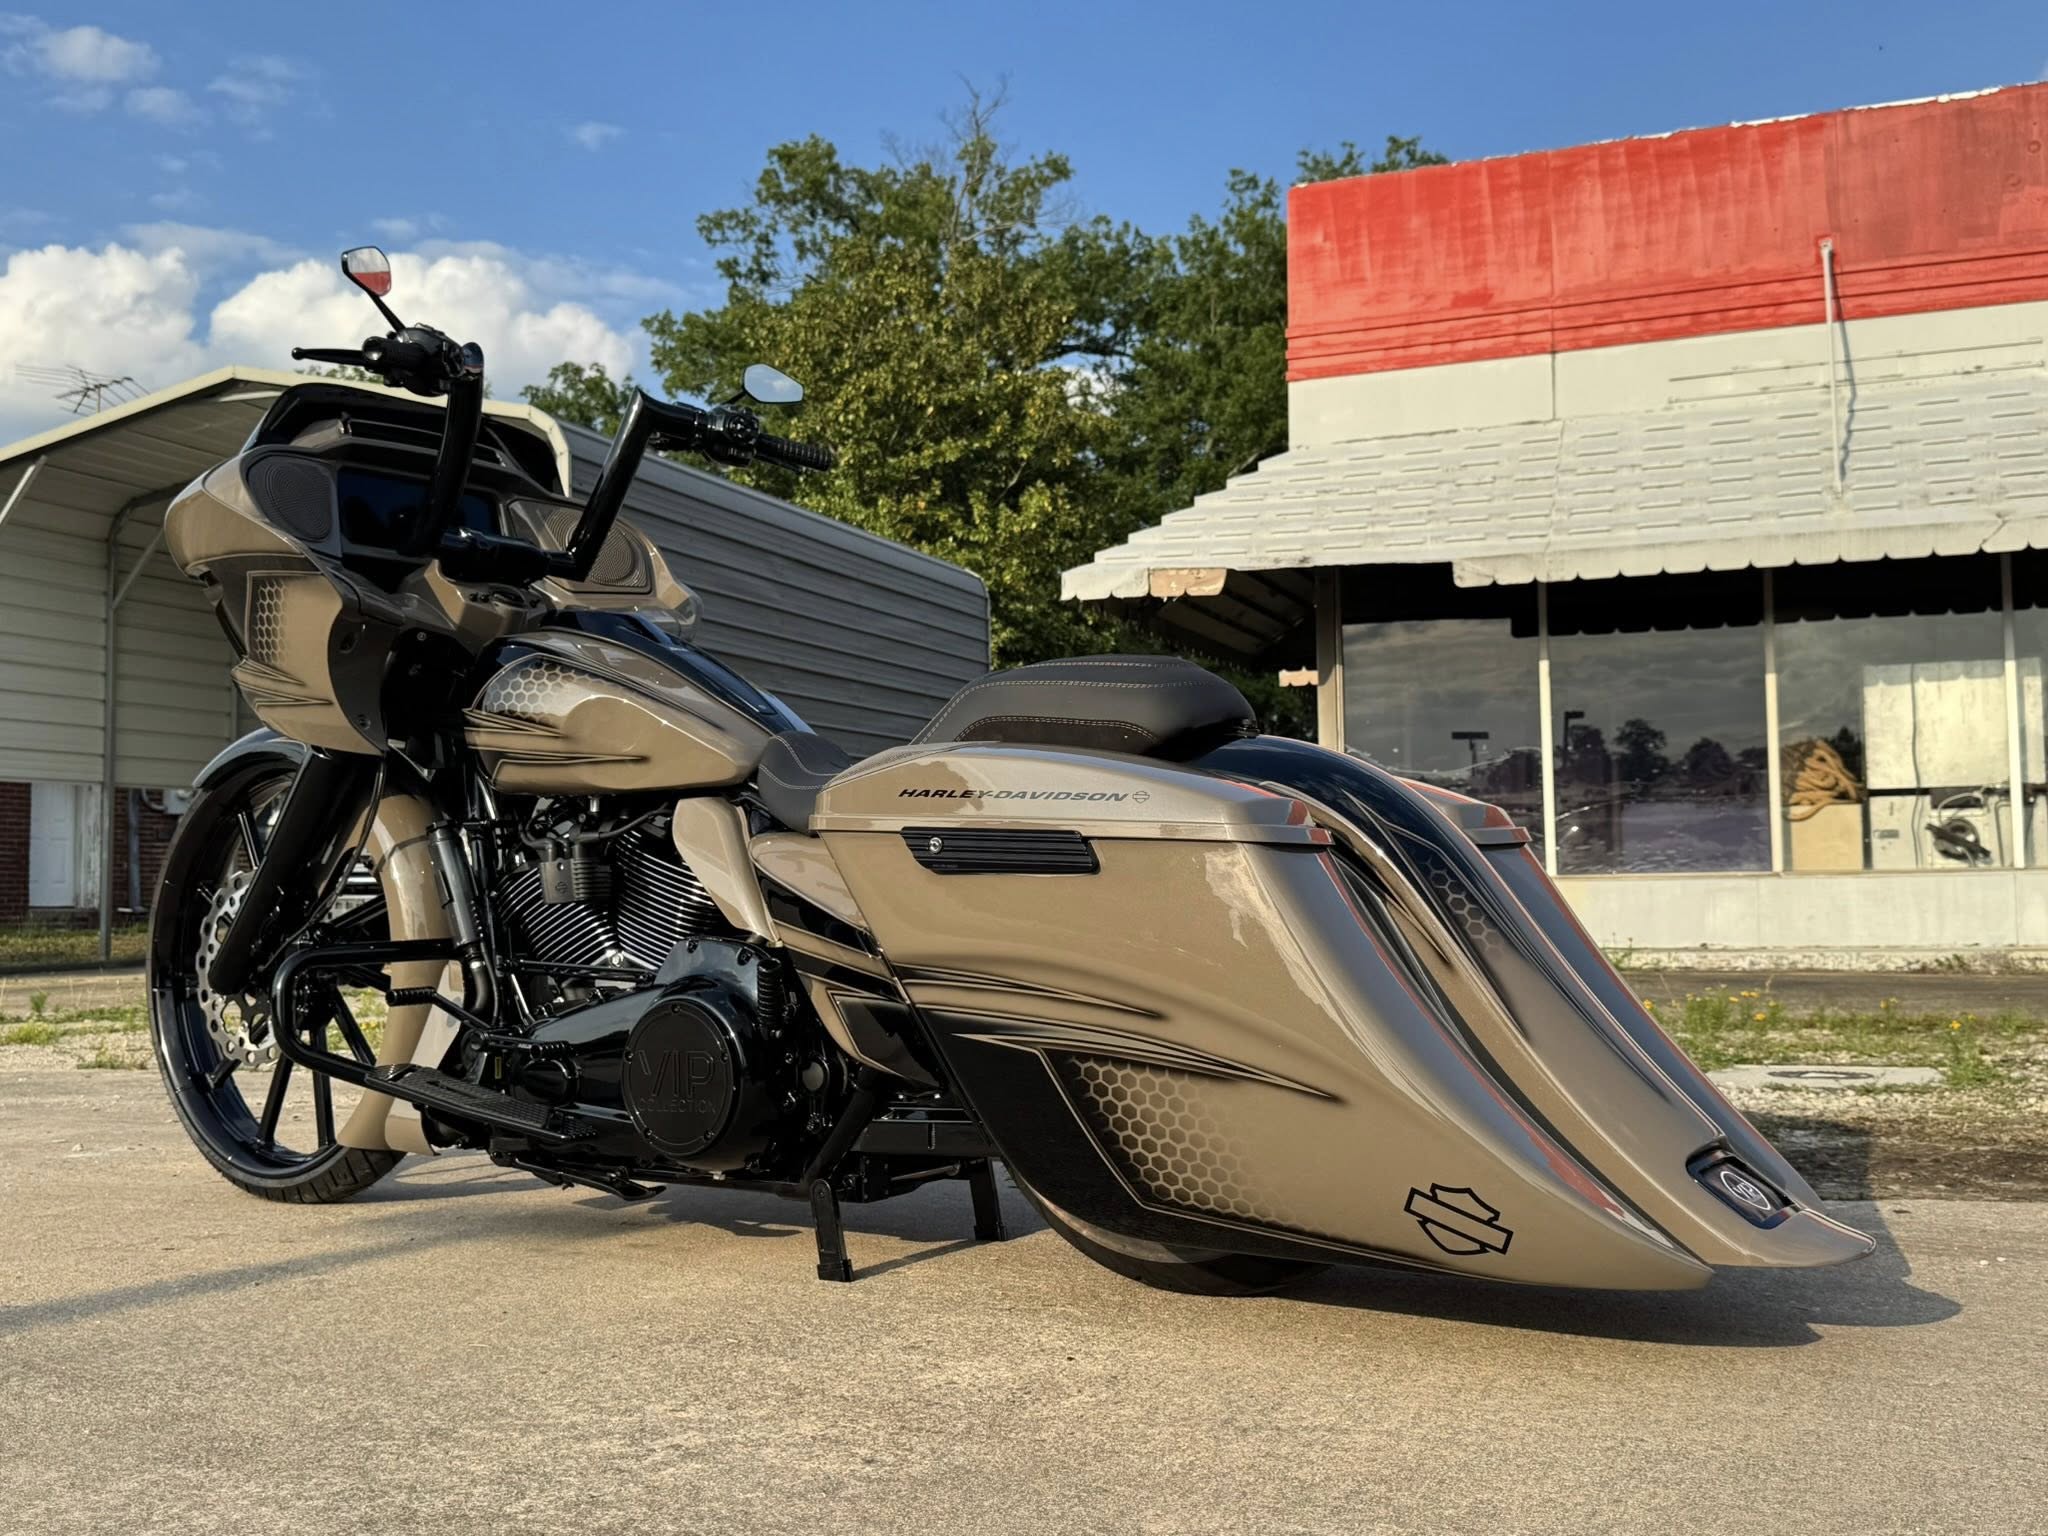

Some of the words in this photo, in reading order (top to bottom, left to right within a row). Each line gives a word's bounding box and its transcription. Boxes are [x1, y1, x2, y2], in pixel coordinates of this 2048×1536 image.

[898, 788, 1128, 803] HARLEY-DAVIDSON
[636, 1049, 715, 1099] VIP
[639, 1098, 717, 1114] COLLECTION
